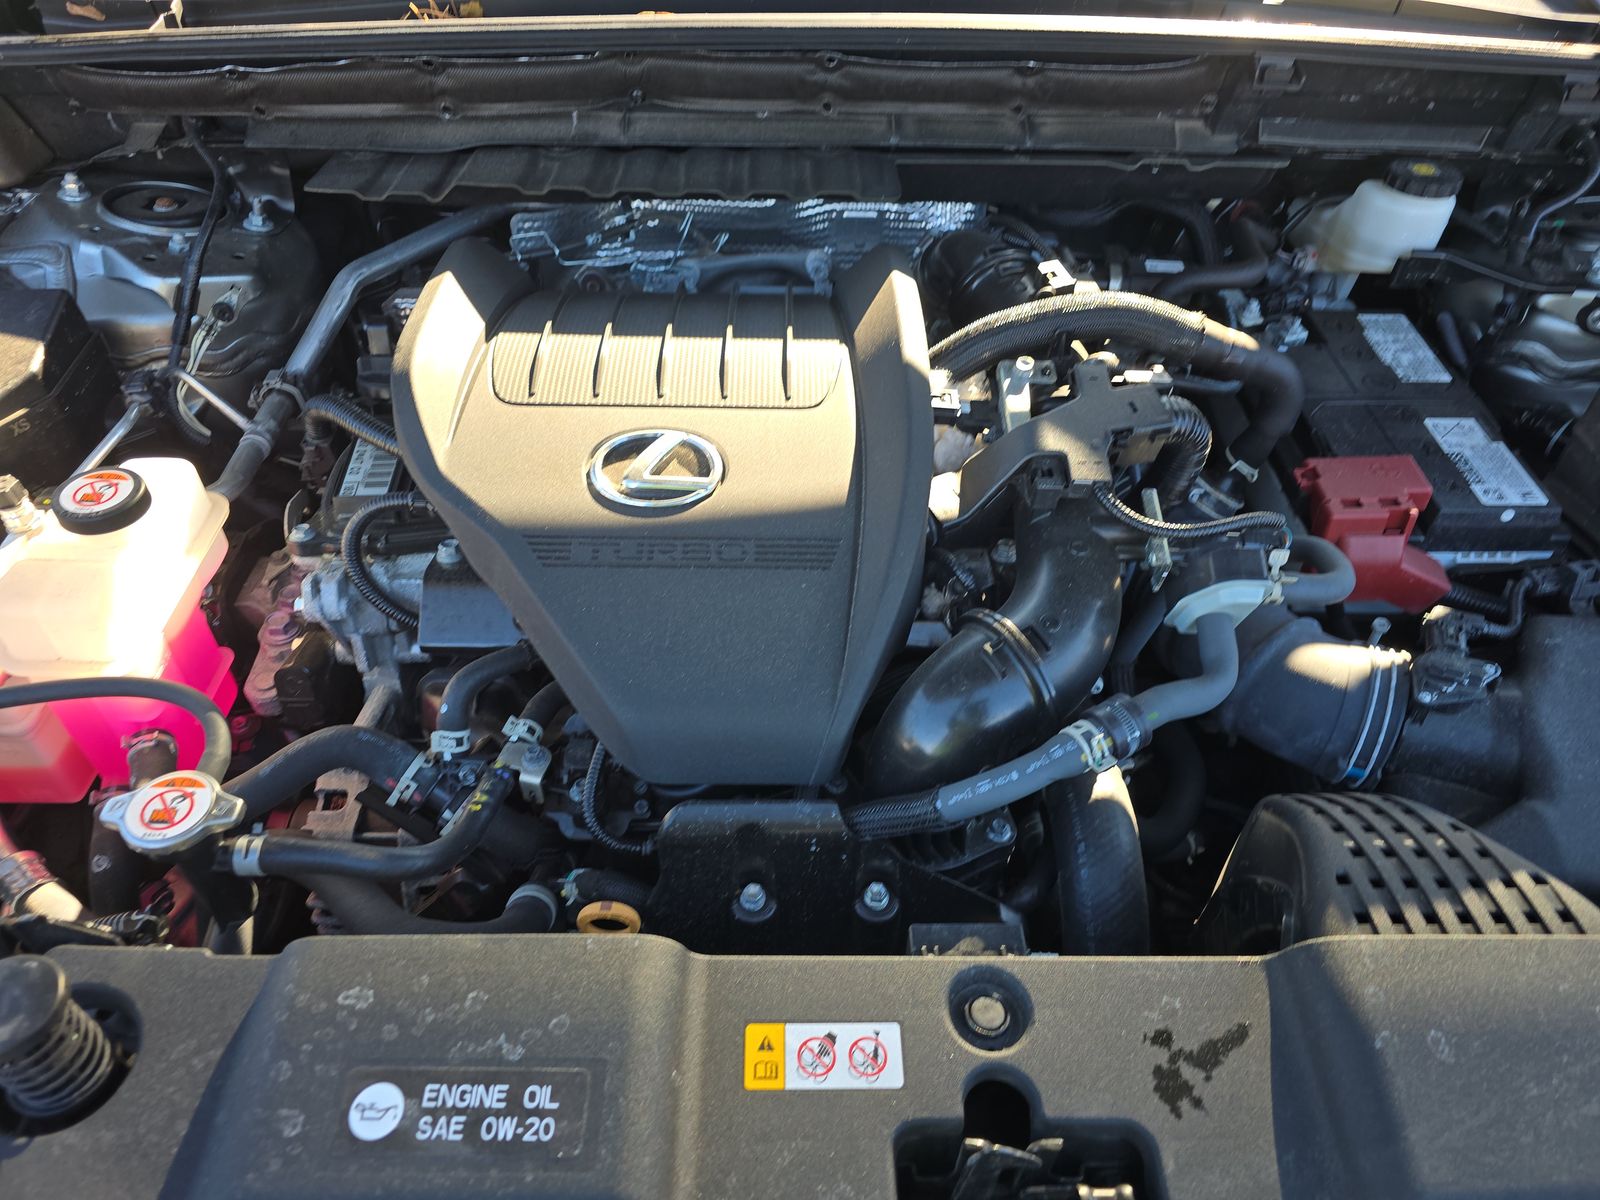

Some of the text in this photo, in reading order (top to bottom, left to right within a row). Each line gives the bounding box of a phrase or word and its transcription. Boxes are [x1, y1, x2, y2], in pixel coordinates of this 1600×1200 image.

[578, 540, 747, 562] TURBO
[421, 1083, 560, 1109] ENGINE OIL
[415, 1115, 556, 1142] SAE 0W-20
